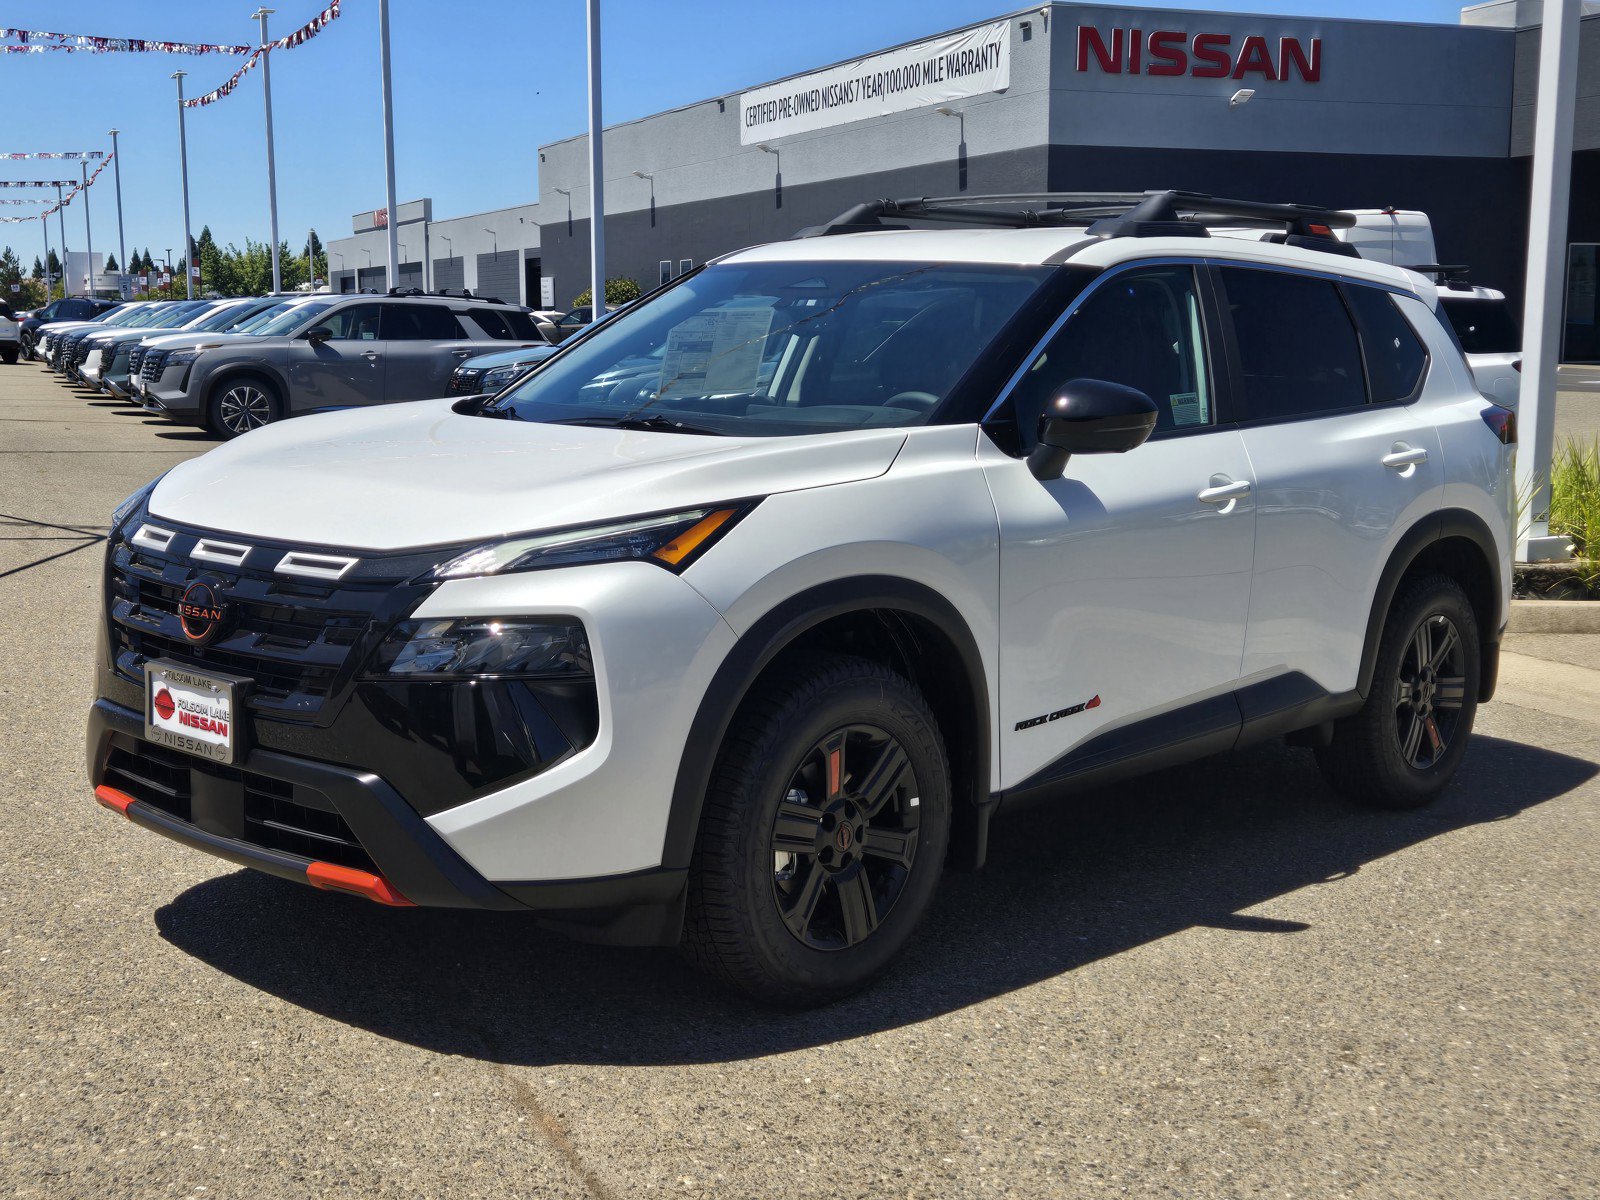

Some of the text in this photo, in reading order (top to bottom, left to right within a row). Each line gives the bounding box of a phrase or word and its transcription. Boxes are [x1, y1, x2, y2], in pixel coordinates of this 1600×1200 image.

[1076, 25, 1322, 82] NISSAN
[745, 40, 1002, 127] CERTIFIED PRE-OWNED NISSANS 7 YEAR/100,000 MILE WARRANTY
[164, 669, 213, 689] FOLSOM LAKE
[178, 697, 230, 723] FOLSOM LAKE
[178, 710, 228, 738] NISSAN
[1014, 702, 1086, 732] ROCK CREEK
[164, 732, 212, 756] NISSAN
